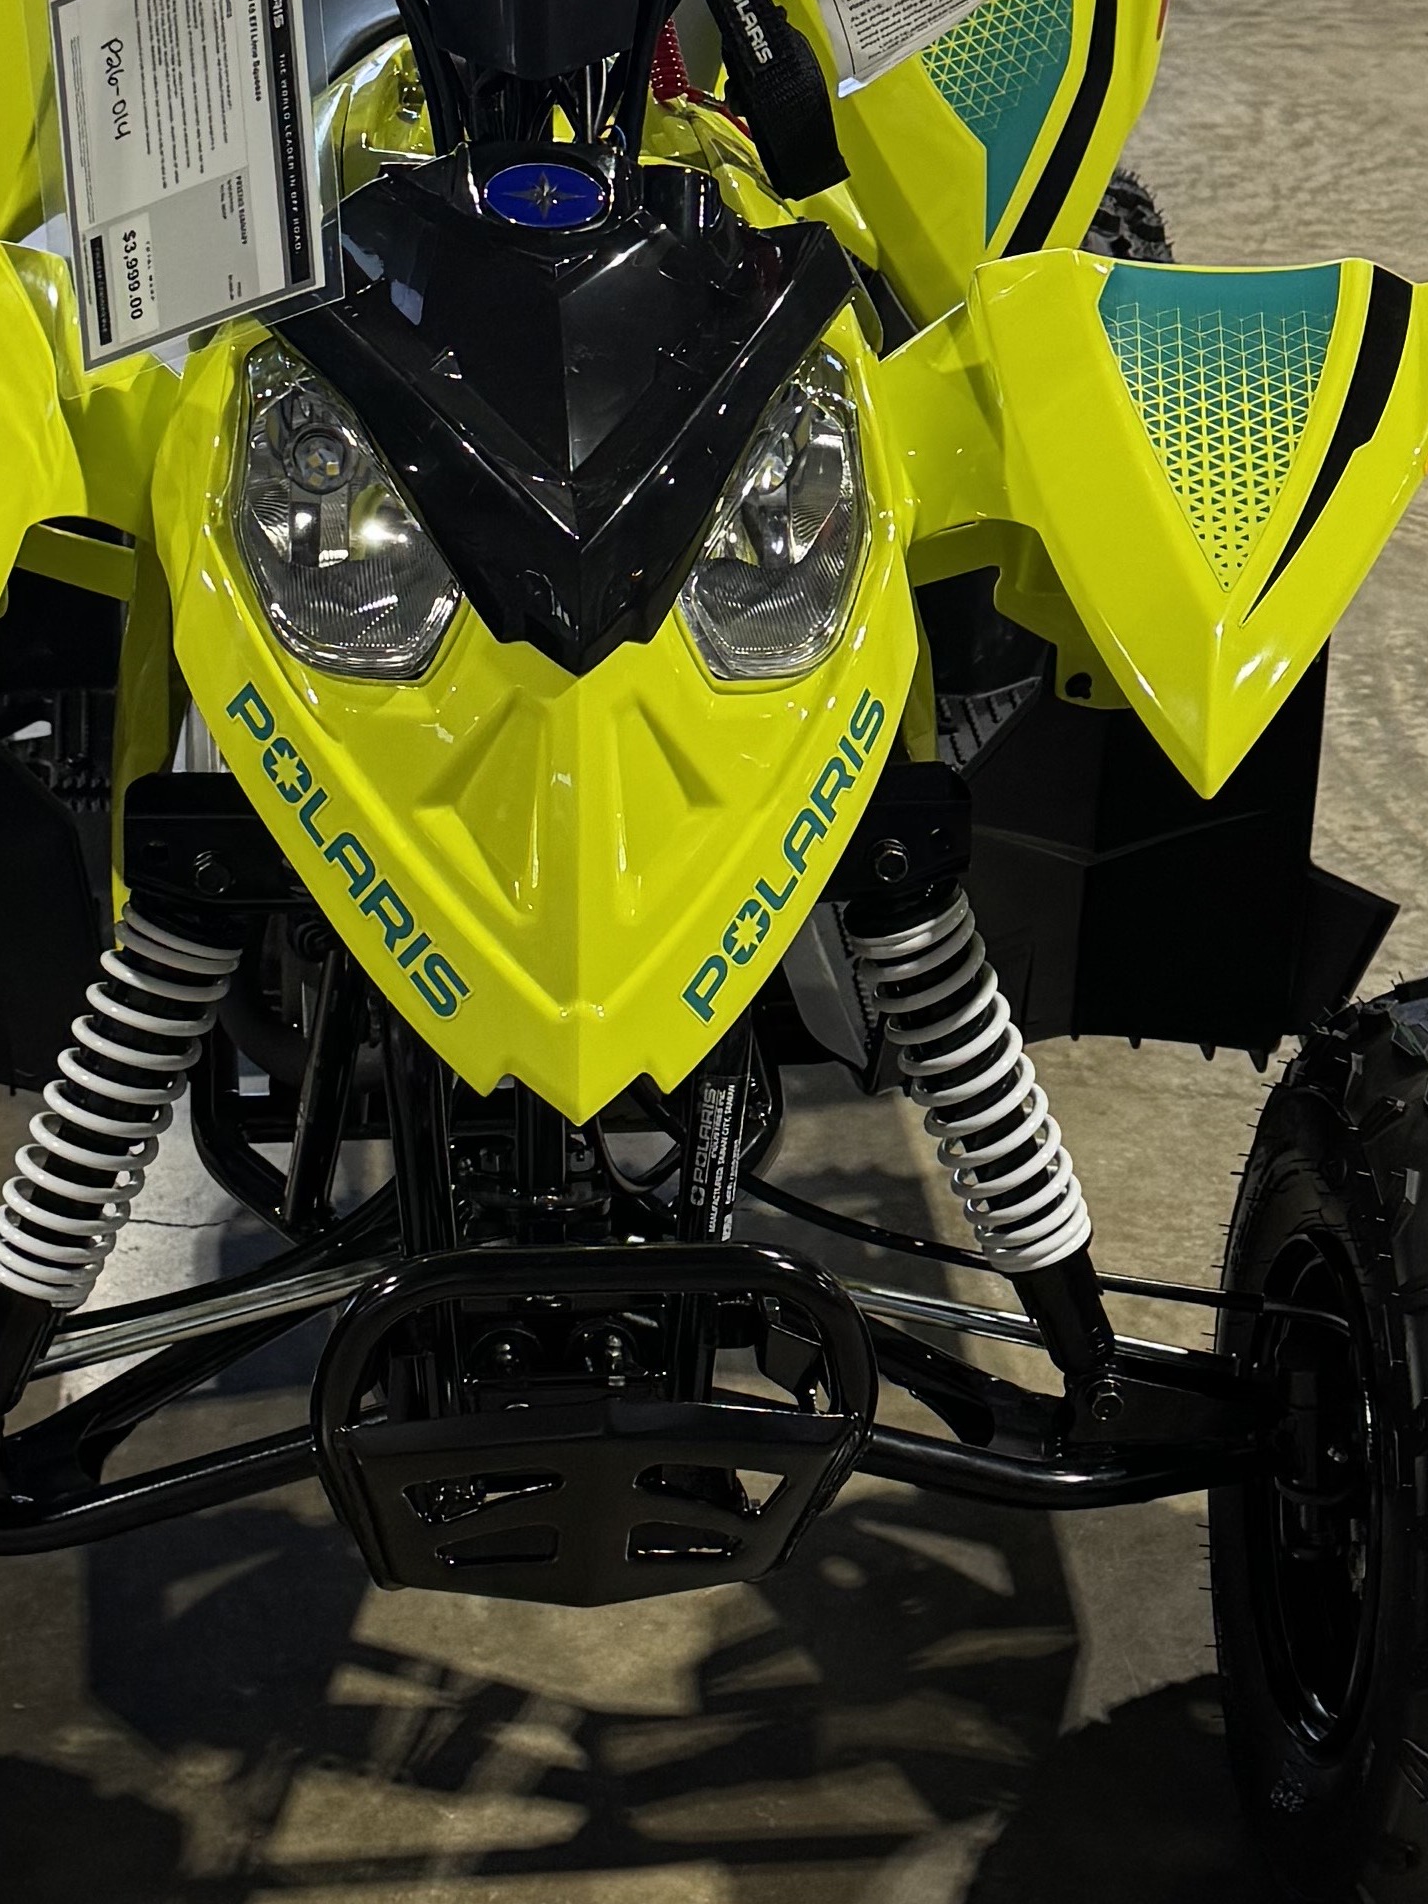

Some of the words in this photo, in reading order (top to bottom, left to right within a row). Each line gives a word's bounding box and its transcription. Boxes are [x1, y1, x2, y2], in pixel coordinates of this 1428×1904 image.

[280, 79, 290, 120] WORLD
[285, 125, 294, 170] LEADER
[122, 230, 144, 320] $3,999.00
[226, 681, 470, 1017] POLARIS
[682, 687, 885, 1023] POLARIS
[693, 1087, 716, 1183] POLARIS
